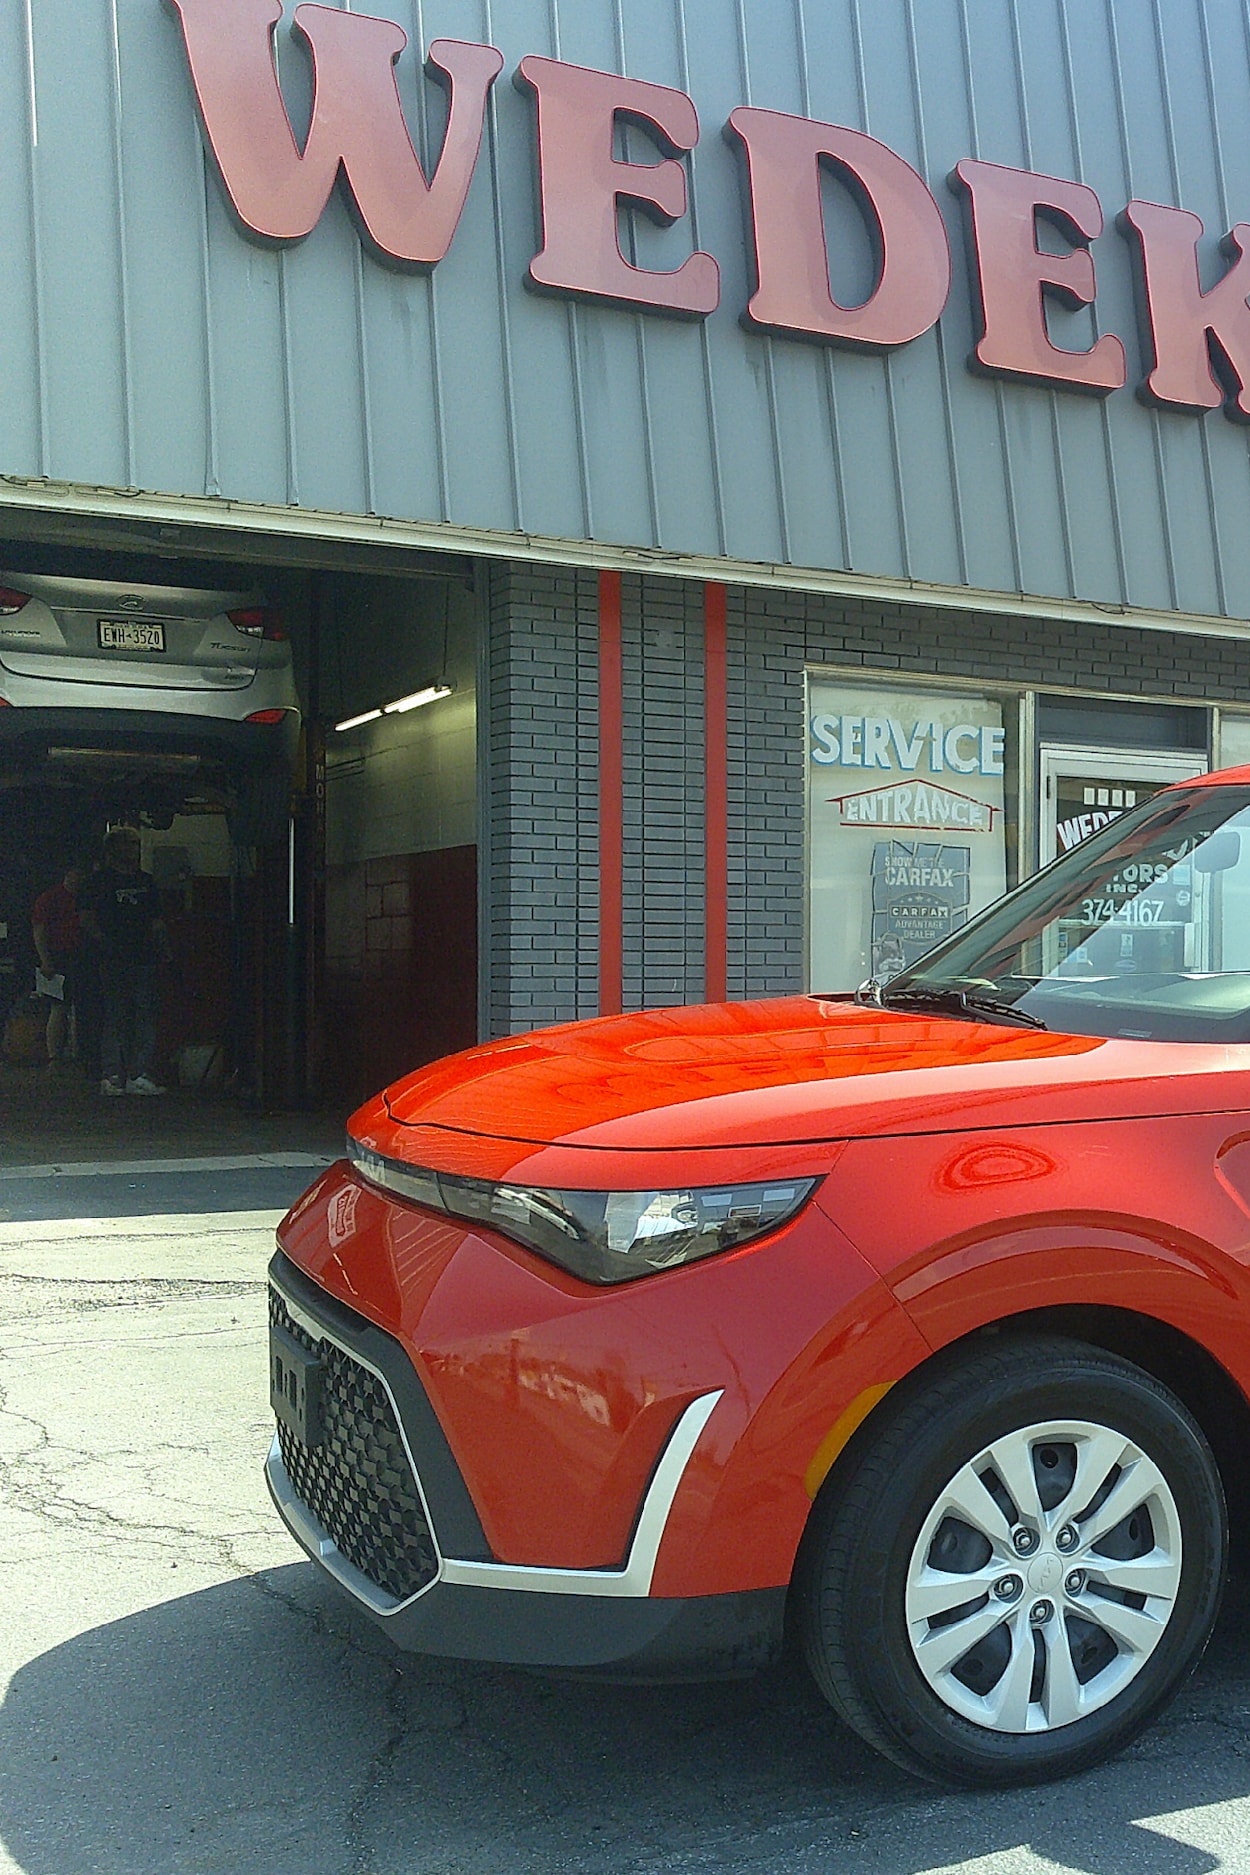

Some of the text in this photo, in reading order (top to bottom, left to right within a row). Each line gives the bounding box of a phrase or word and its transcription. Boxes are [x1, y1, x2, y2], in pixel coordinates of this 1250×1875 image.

[810, 714, 1006, 776] SERVICE
[846, 784, 984, 826] ENTRANCE
[885, 867, 954, 887] CARFAX
[892, 906, 948, 918] CARFAX
[895, 919, 943, 930] ADVANTAGE
[903, 930, 936, 939] DEALER
